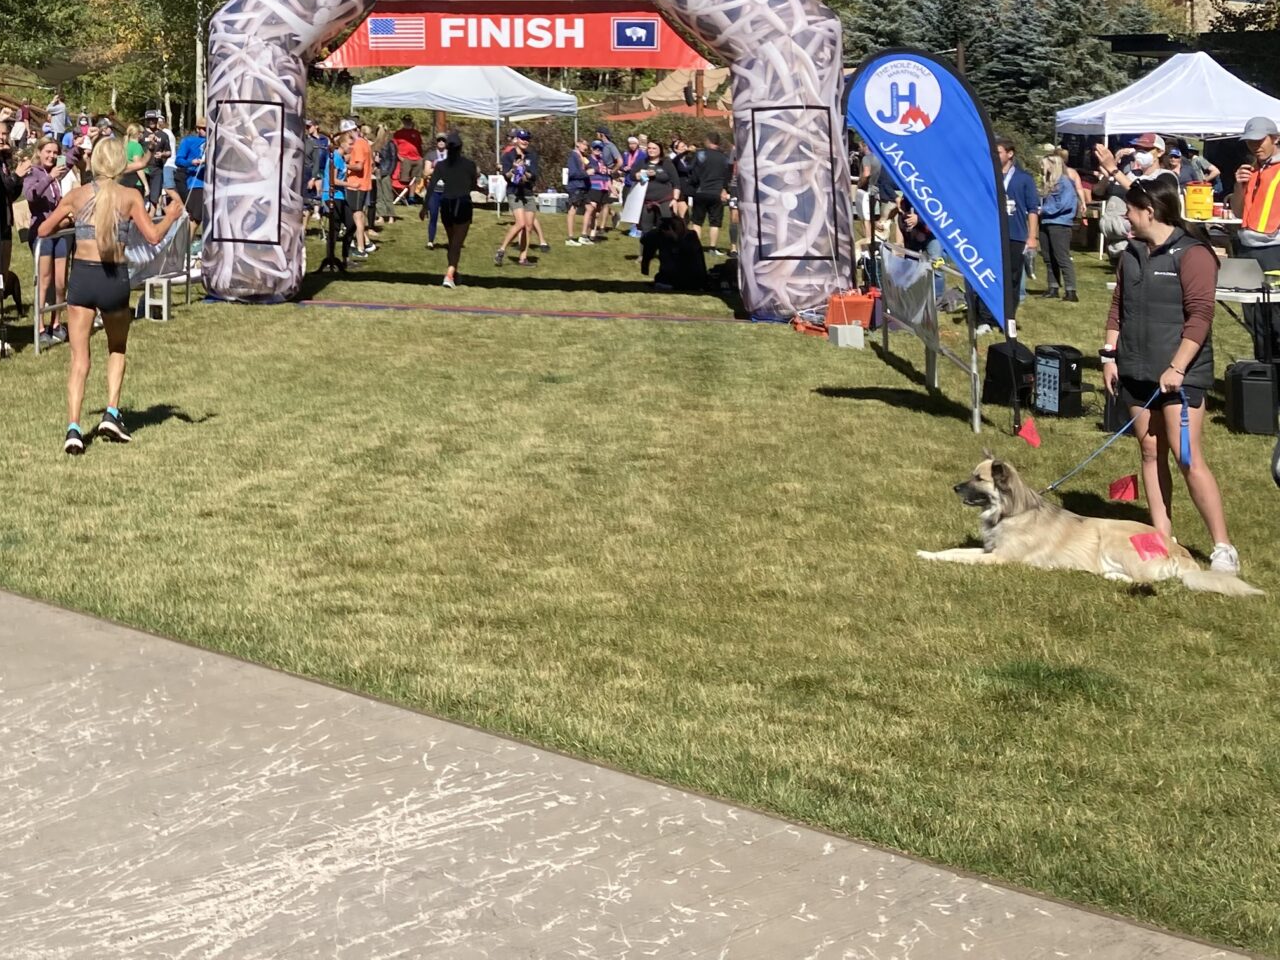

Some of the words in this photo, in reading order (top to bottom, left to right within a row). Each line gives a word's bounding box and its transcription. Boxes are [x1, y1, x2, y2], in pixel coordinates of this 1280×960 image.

[440, 17, 585, 49] FINISH
[879, 140, 954, 230] JACKSON
[947, 228, 997, 289] HOLE
